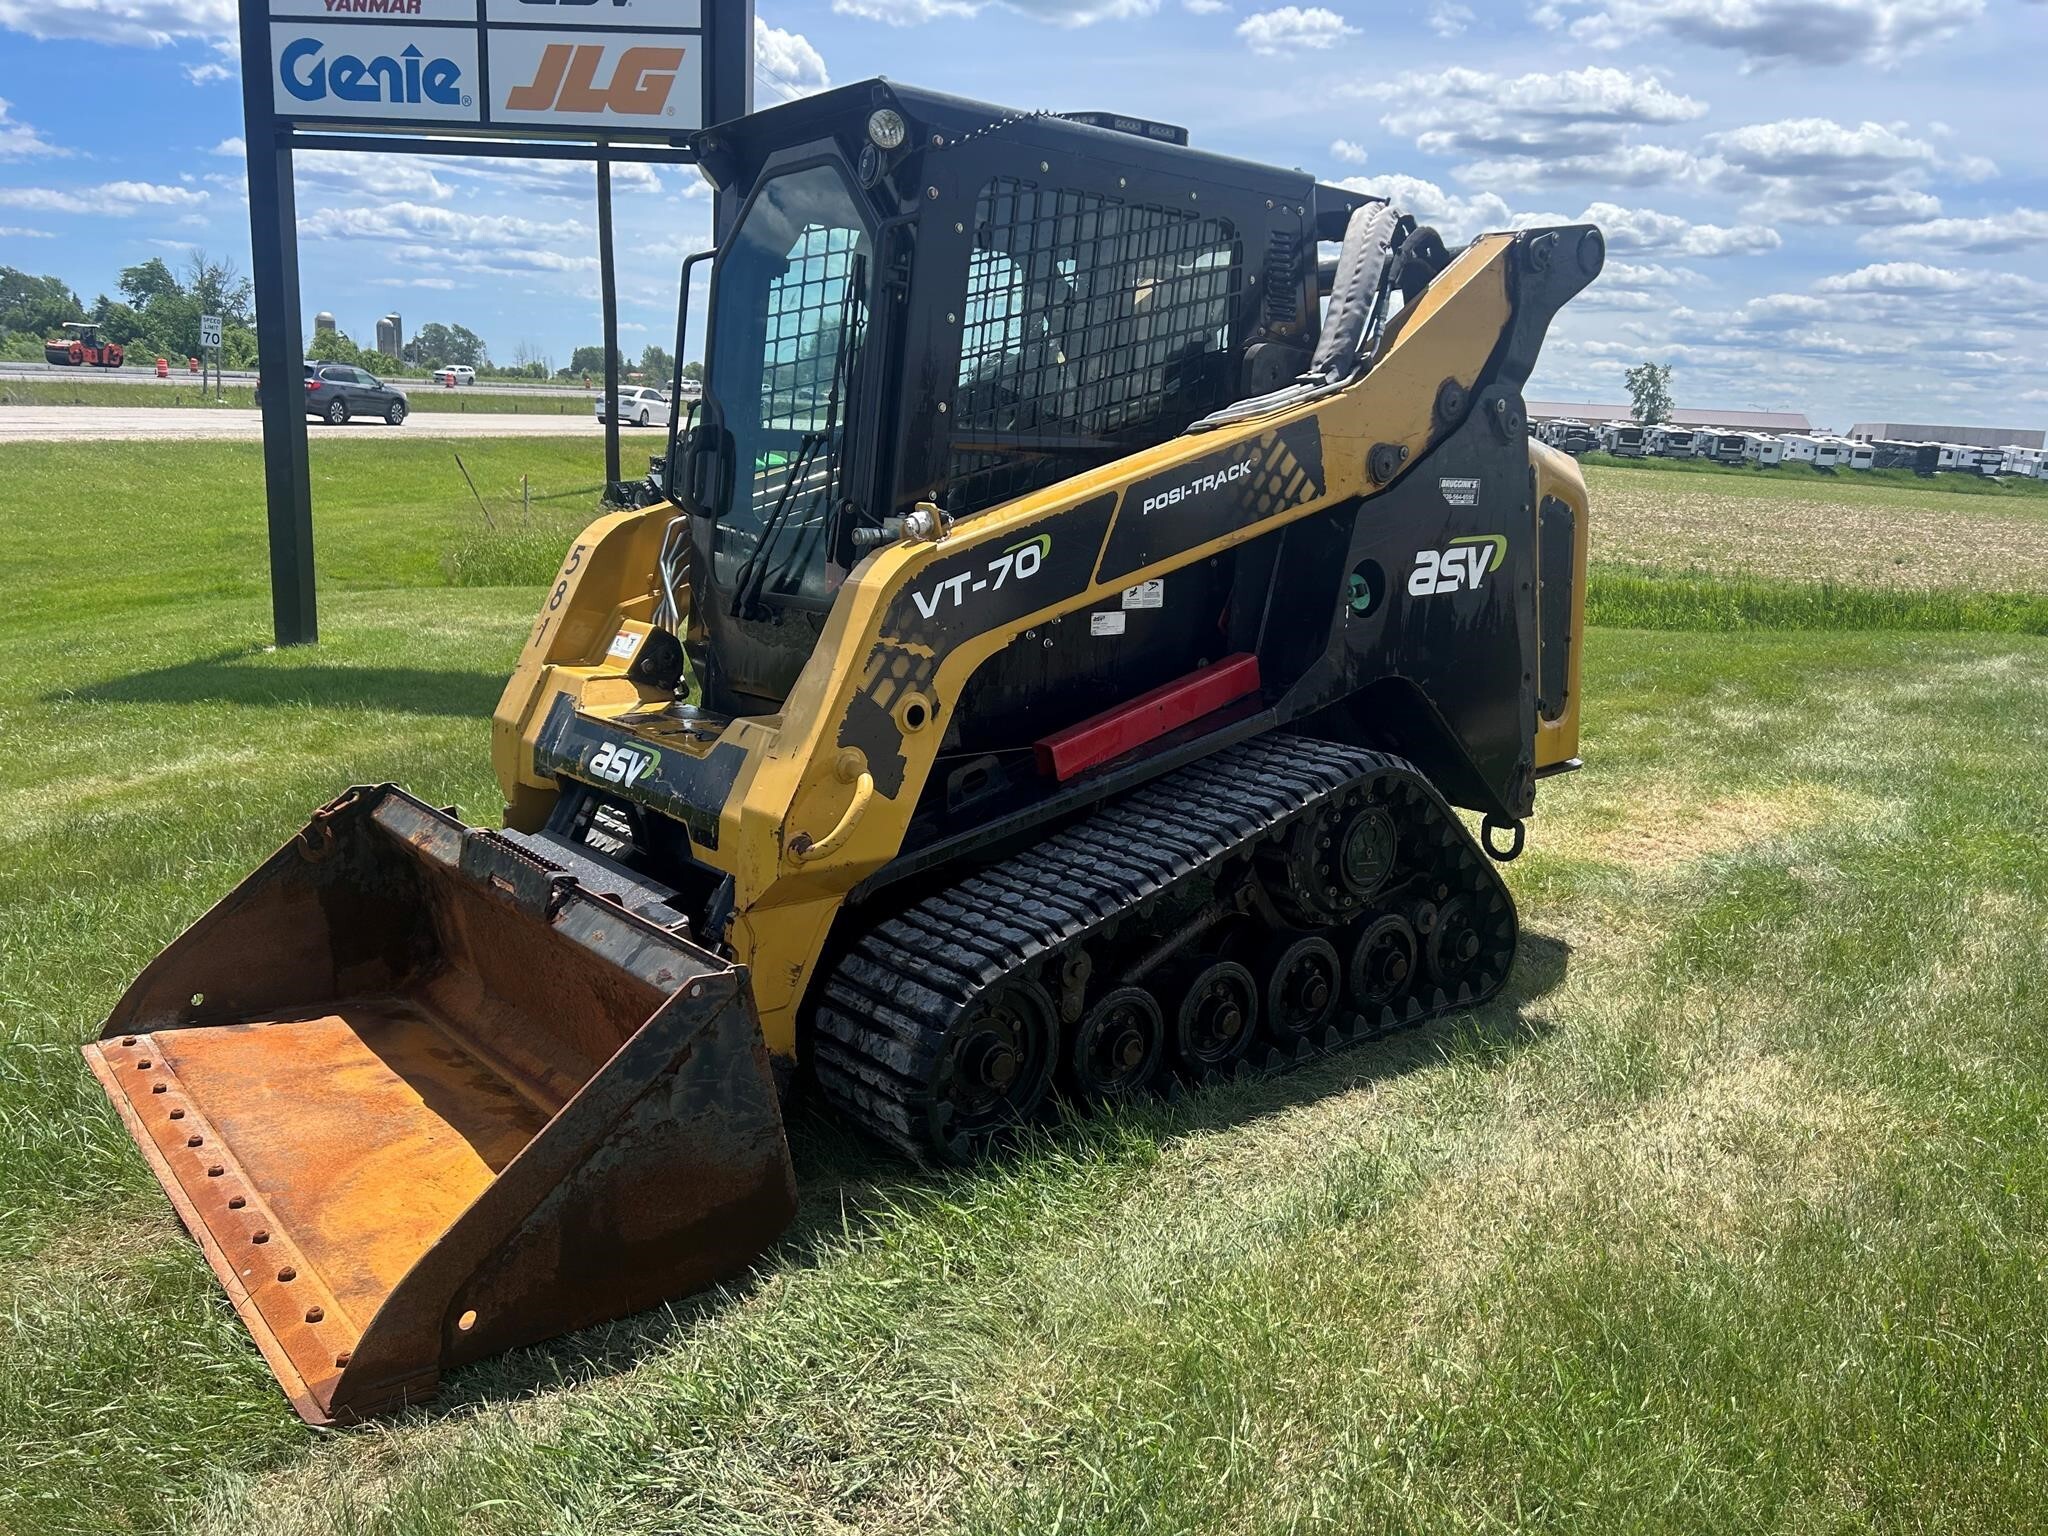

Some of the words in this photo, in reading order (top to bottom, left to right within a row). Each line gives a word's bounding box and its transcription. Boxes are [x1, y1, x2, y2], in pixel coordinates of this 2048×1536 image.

[280, 37, 462, 106] Genie
[505, 43, 686, 115] JLG
[203, 331, 220, 345] 70
[1143, 459, 1252, 515] POSI-TRACK
[911, 544, 1041, 619] VT-70
